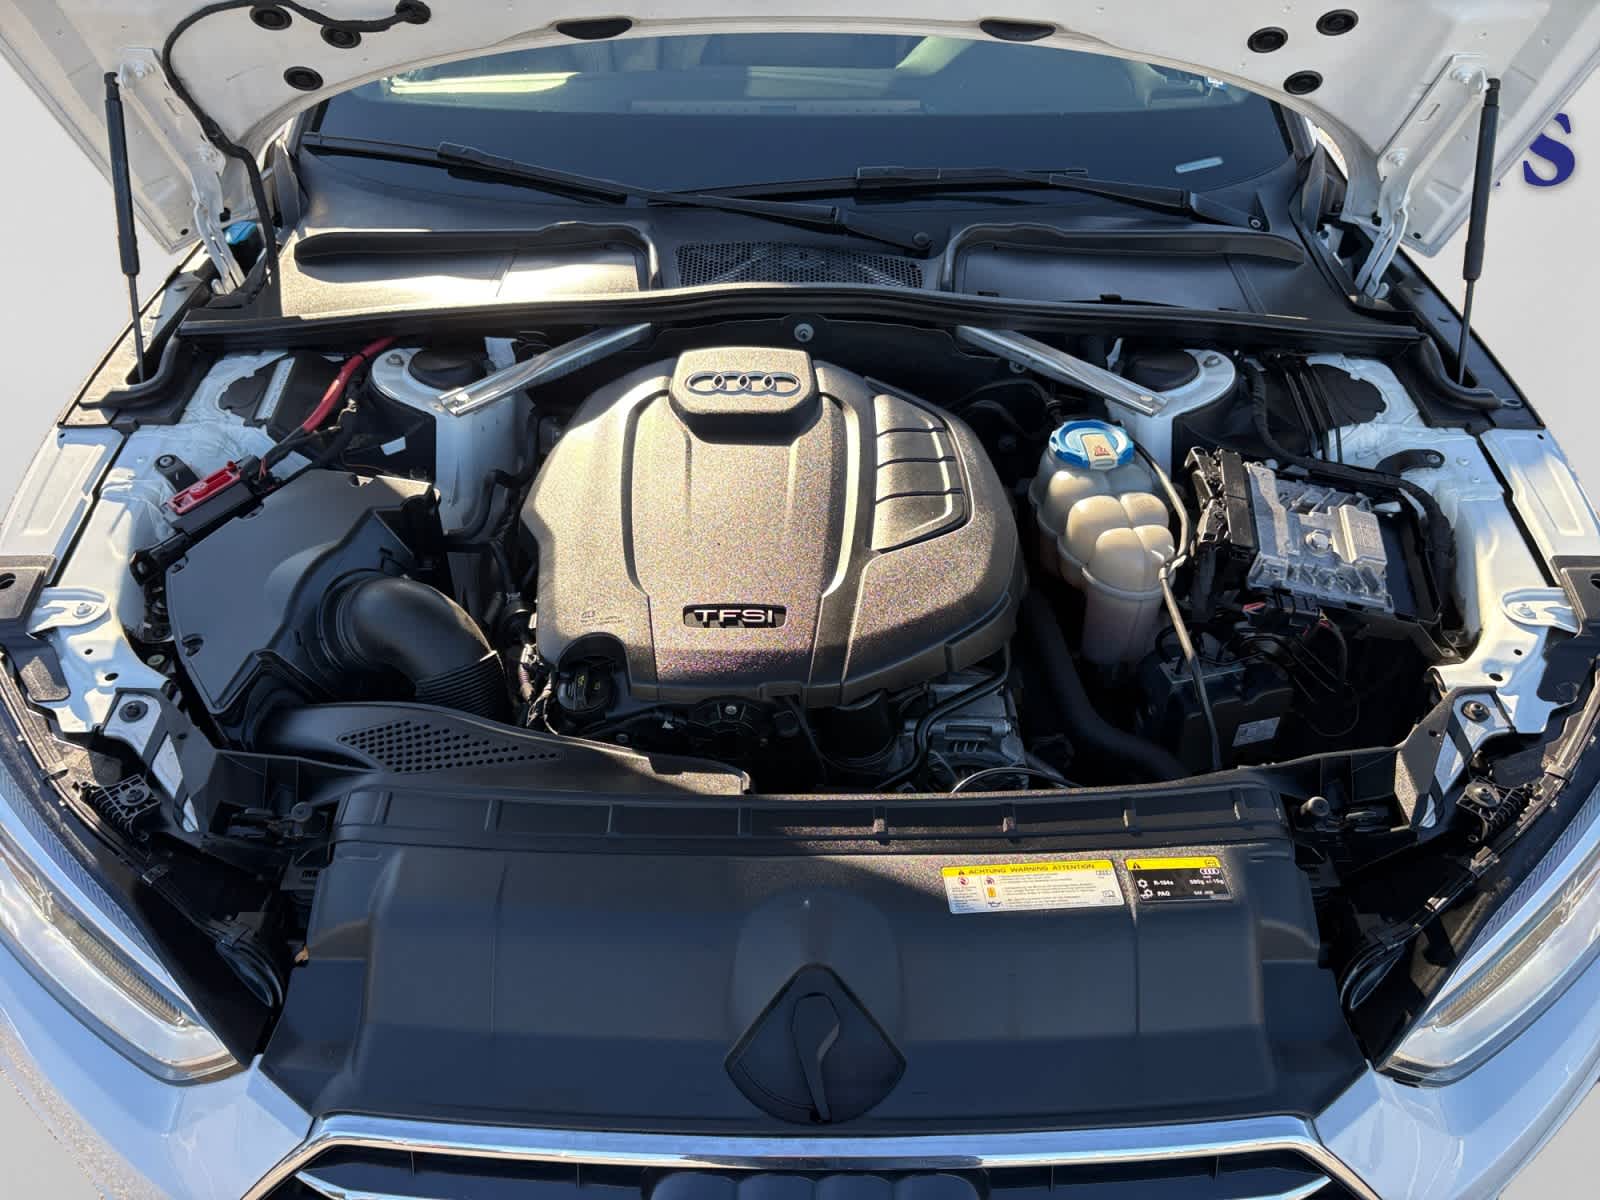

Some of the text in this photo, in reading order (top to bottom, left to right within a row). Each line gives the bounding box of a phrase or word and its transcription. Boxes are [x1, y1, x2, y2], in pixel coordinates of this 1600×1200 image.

[694, 609, 773, 623] TFSI
[968, 863, 1096, 875] ACHTUNG WARNING ATTENTION
